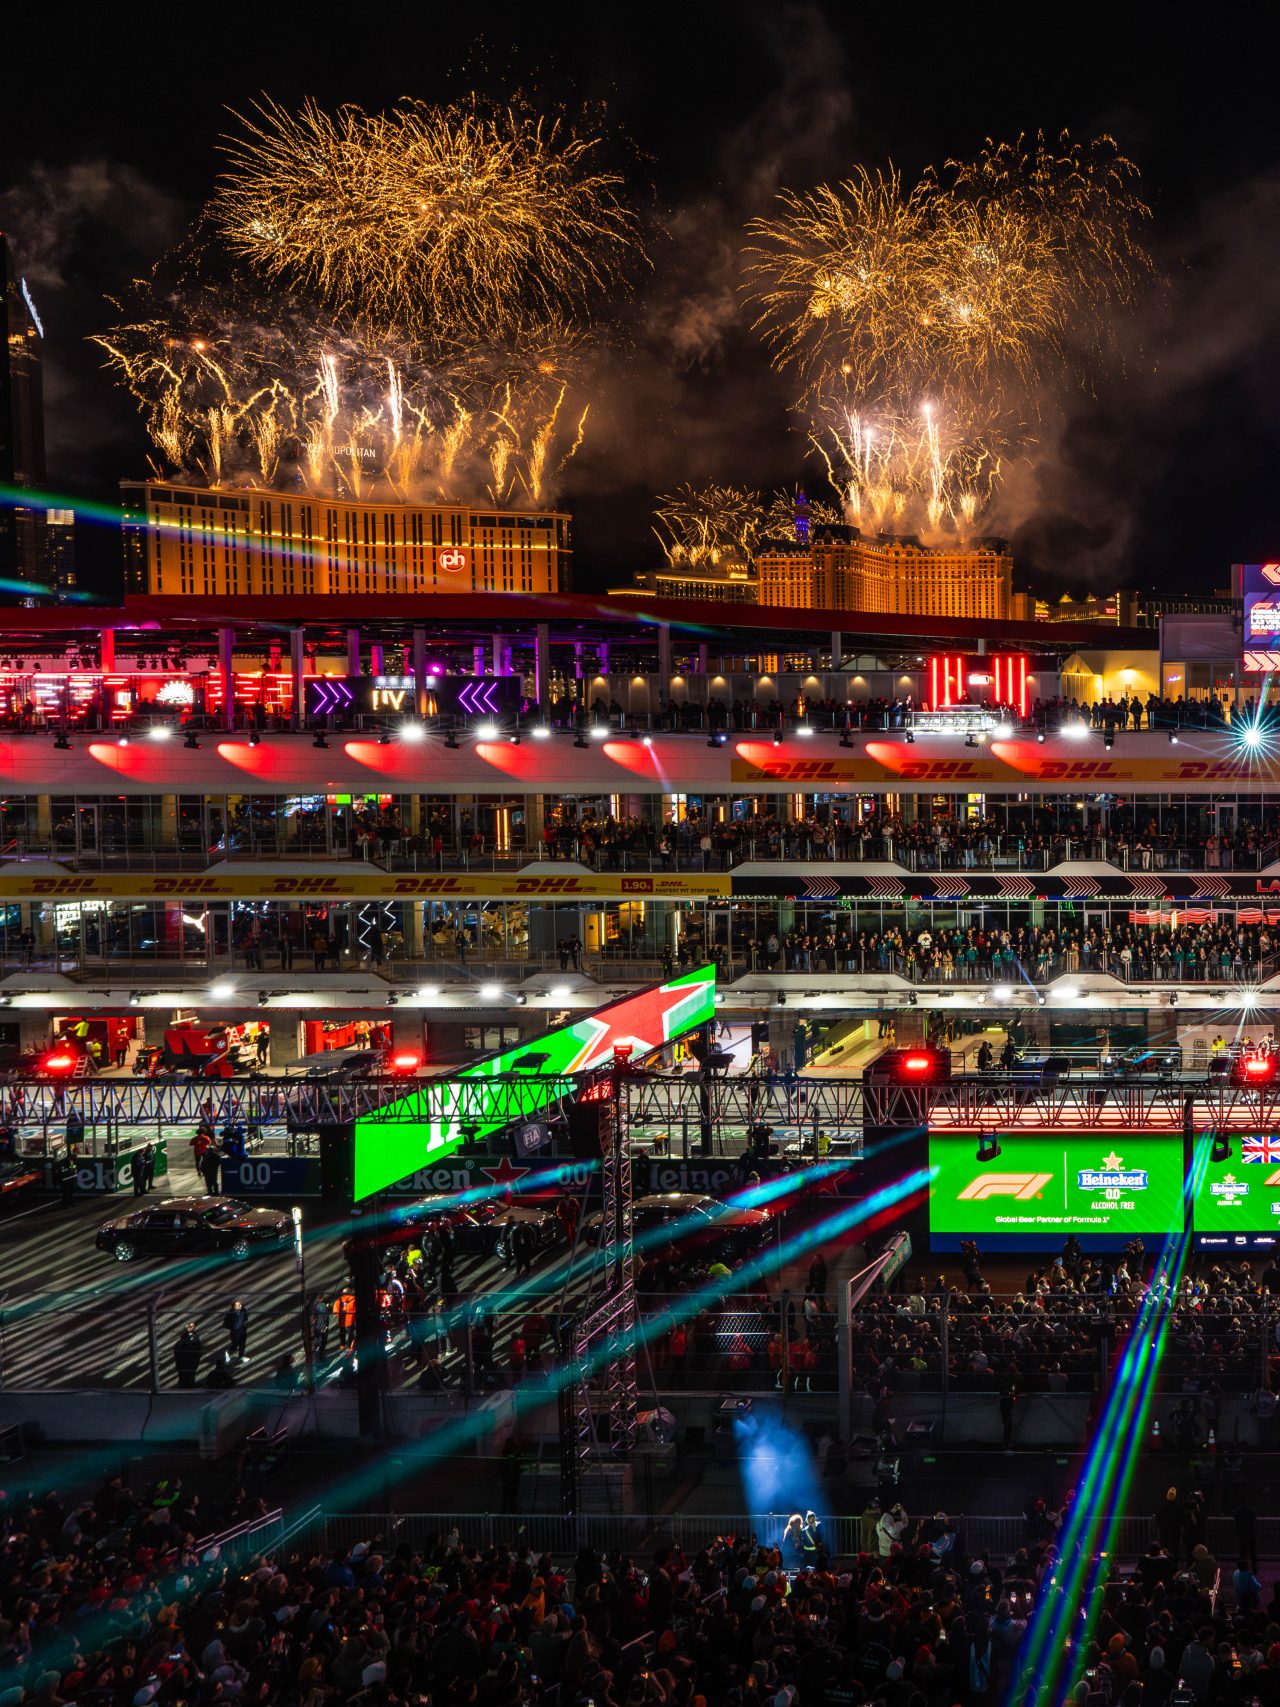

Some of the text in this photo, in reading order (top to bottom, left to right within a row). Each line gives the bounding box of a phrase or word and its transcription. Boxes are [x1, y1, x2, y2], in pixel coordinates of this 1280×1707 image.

[442, 549, 466, 569] ph
[761, 763, 839, 779] DHL
[900, 763, 979, 779] DHL
[1038, 762, 1119, 778] DHL
[1178, 762, 1257, 778] DHL
[31, 878, 99, 893] DHL
[153, 878, 220, 892] DHL
[273, 878, 341, 892] DHL
[394, 878, 463, 893] DHL
[515, 878, 584, 893] DHL
[524, 1129, 541, 1144] FIA
[240, 1162, 271, 1186] 0.0
[557, 1162, 588, 1186] 0.0
[957, 1174, 1054, 1199] F1
